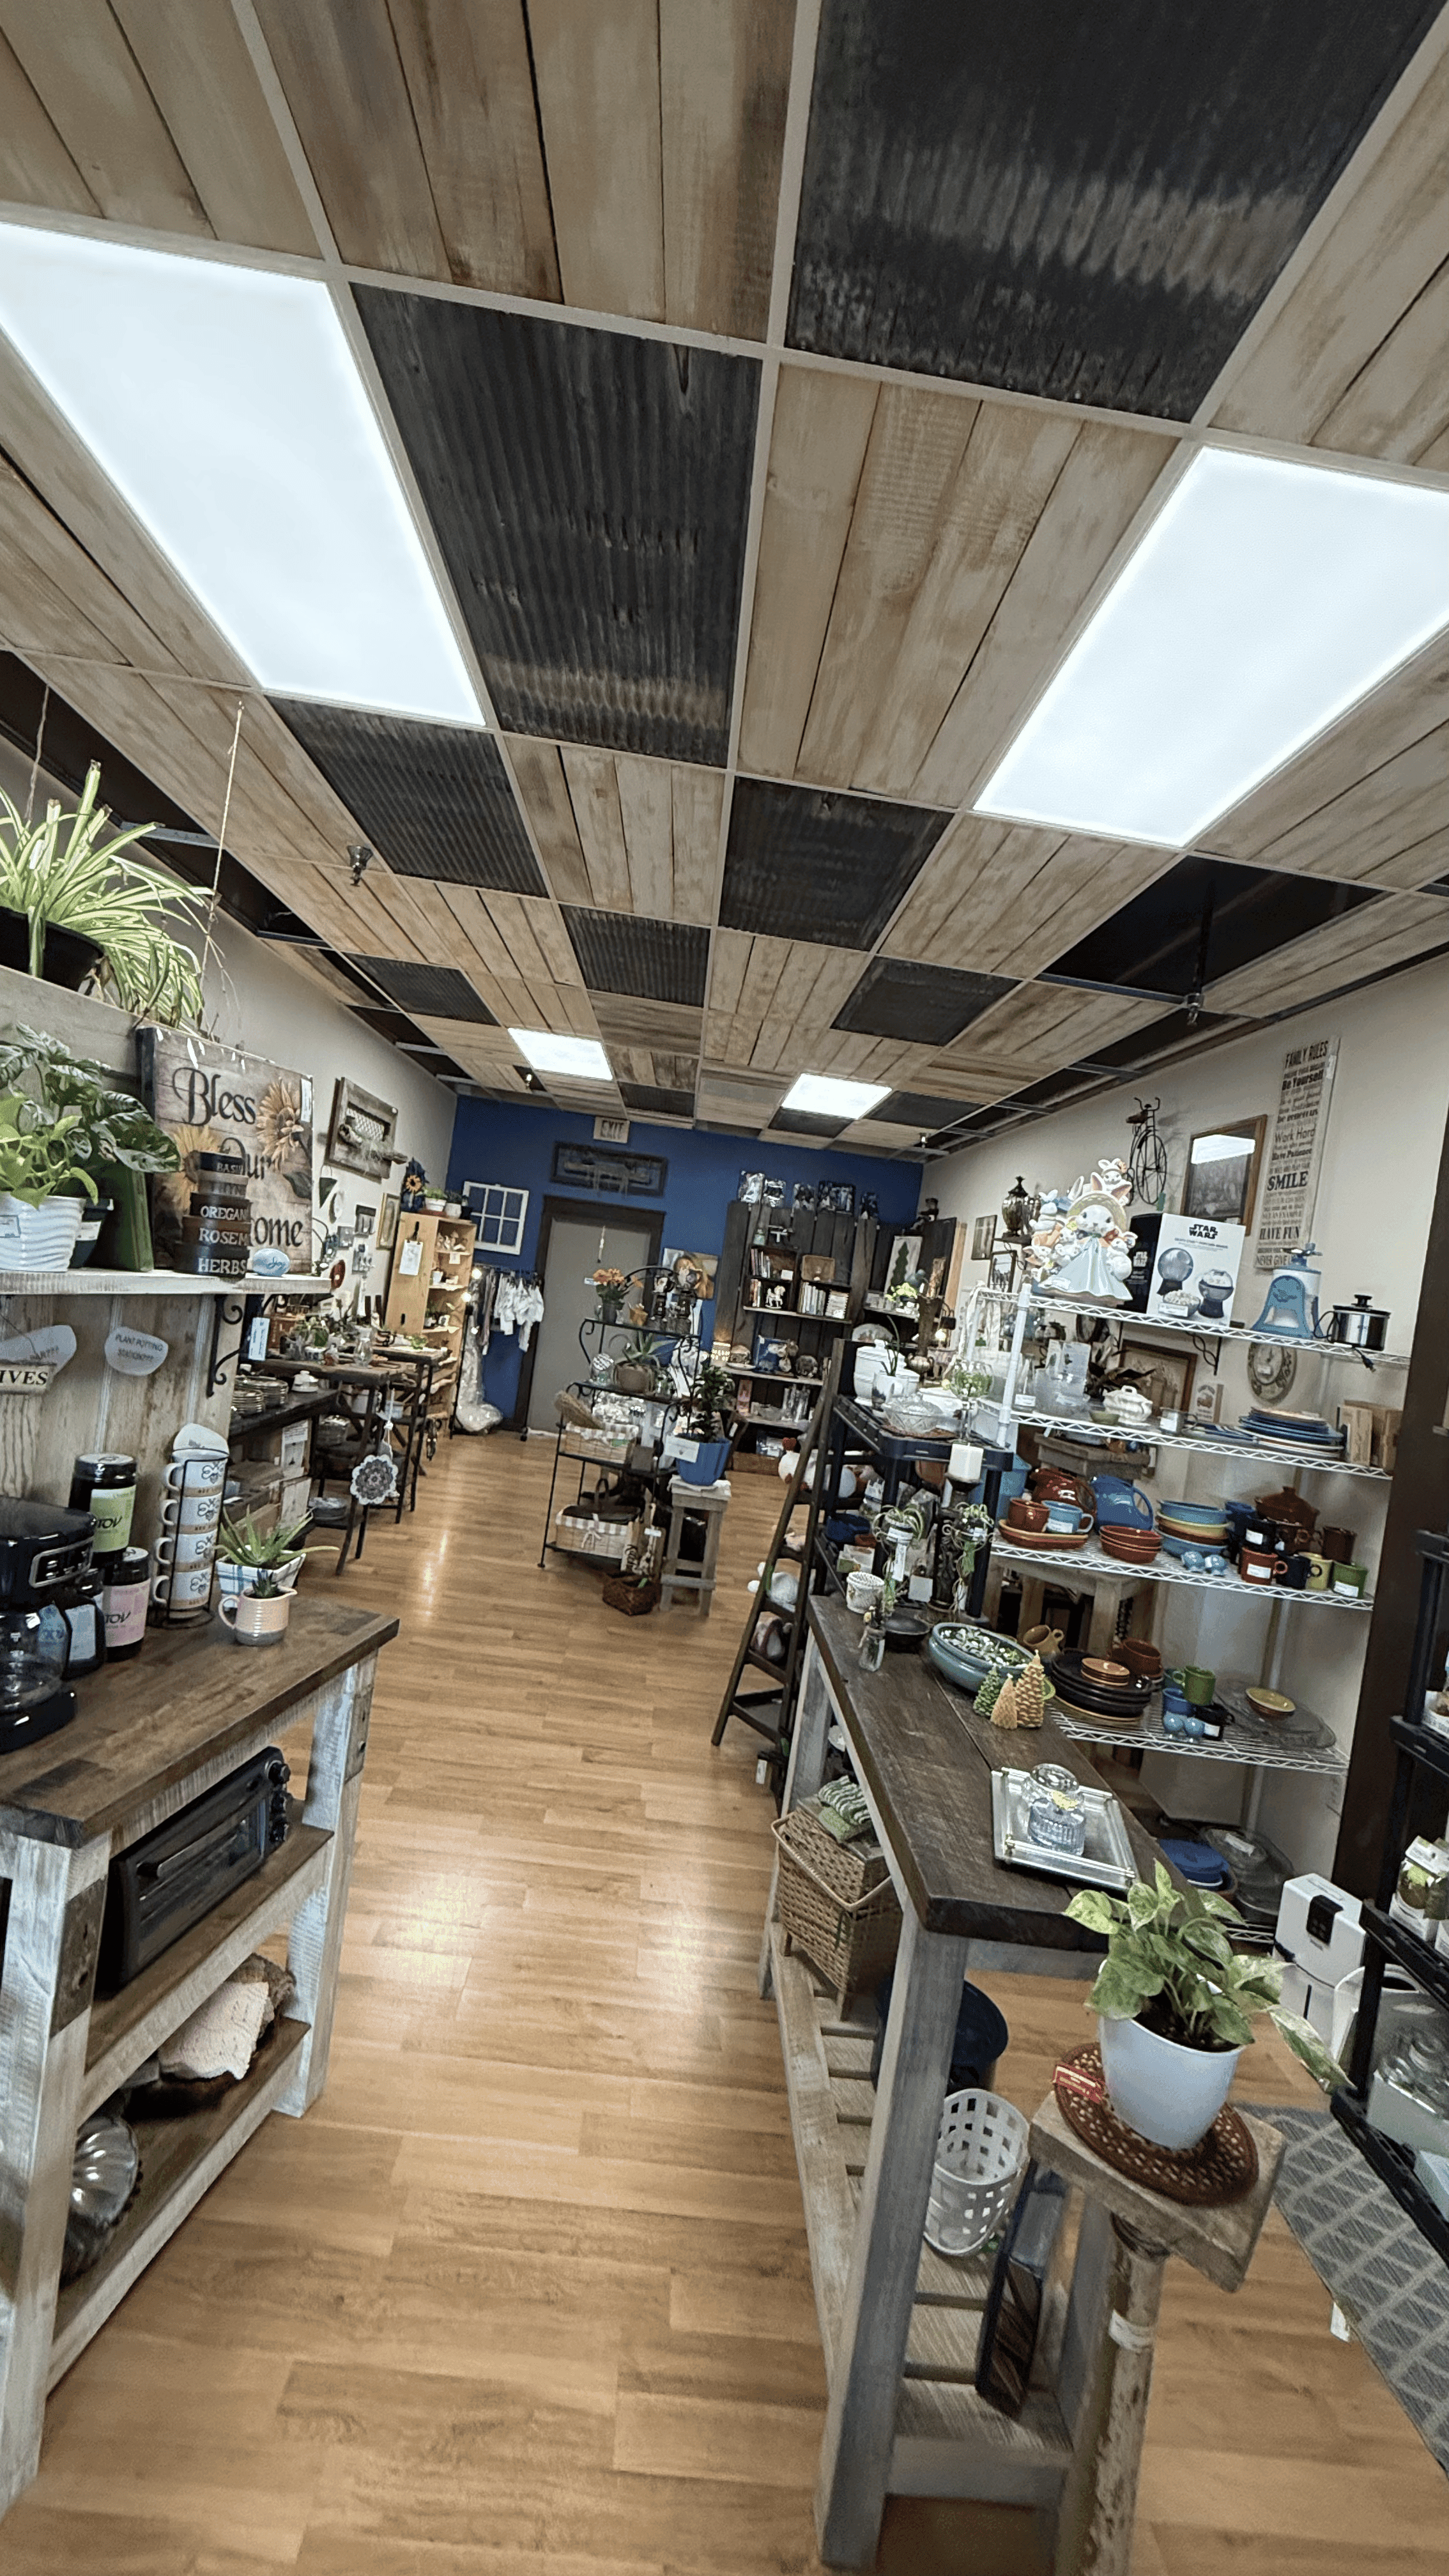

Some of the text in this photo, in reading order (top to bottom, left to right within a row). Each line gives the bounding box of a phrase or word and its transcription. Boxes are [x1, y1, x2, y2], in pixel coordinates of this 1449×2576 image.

[172, 1067, 256, 1126] Bless
[601, 1119, 624, 1139] EXIT
[1267, 1170, 1308, 1191] SMILE
[250, 1216, 303, 1247] ome
[1189, 1223, 1218, 1234] STAR
[1189, 1229, 1218, 1239] WARS
[197, 1257, 247, 1275] HERBS
